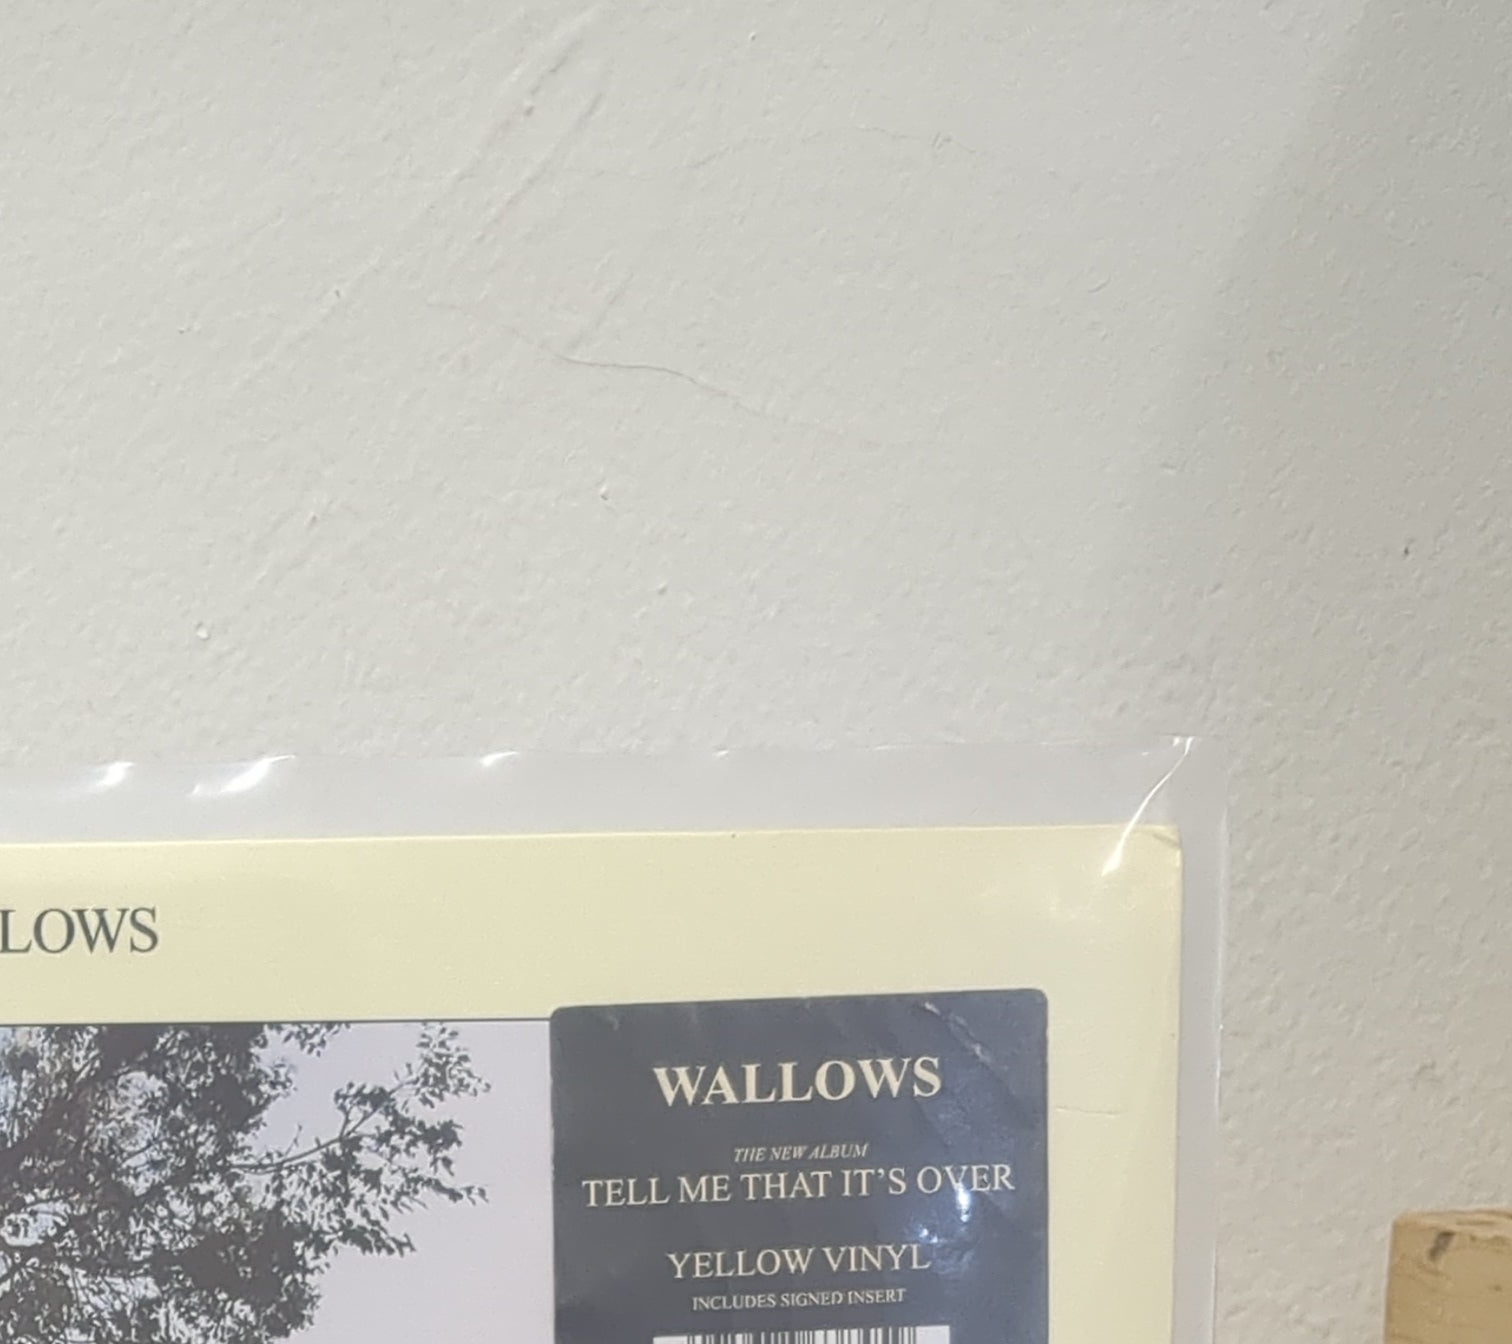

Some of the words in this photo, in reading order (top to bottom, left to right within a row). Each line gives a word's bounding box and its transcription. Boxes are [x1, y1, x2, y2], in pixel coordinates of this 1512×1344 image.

[653, 1056, 942, 1106] WALLOWS
[734, 1147, 766, 1162] THE
[771, 1145, 806, 1160] NEW
[807, 1143, 869, 1159] ALBUM
[582, 1177, 669, 1207] TELL
[678, 1175, 731, 1202] ME
[740, 1171, 832, 1200] THAT
[841, 1168, 906, 1197] IT’S
[917, 1164, 1015, 1194] OVER
[668, 1248, 814, 1279] YELLOW
[822, 1244, 932, 1273] VINYL
[693, 1294, 776, 1311] INCLUDES
[781, 1291, 843, 1308] SIGNED
[848, 1288, 906, 1304] INSERT
